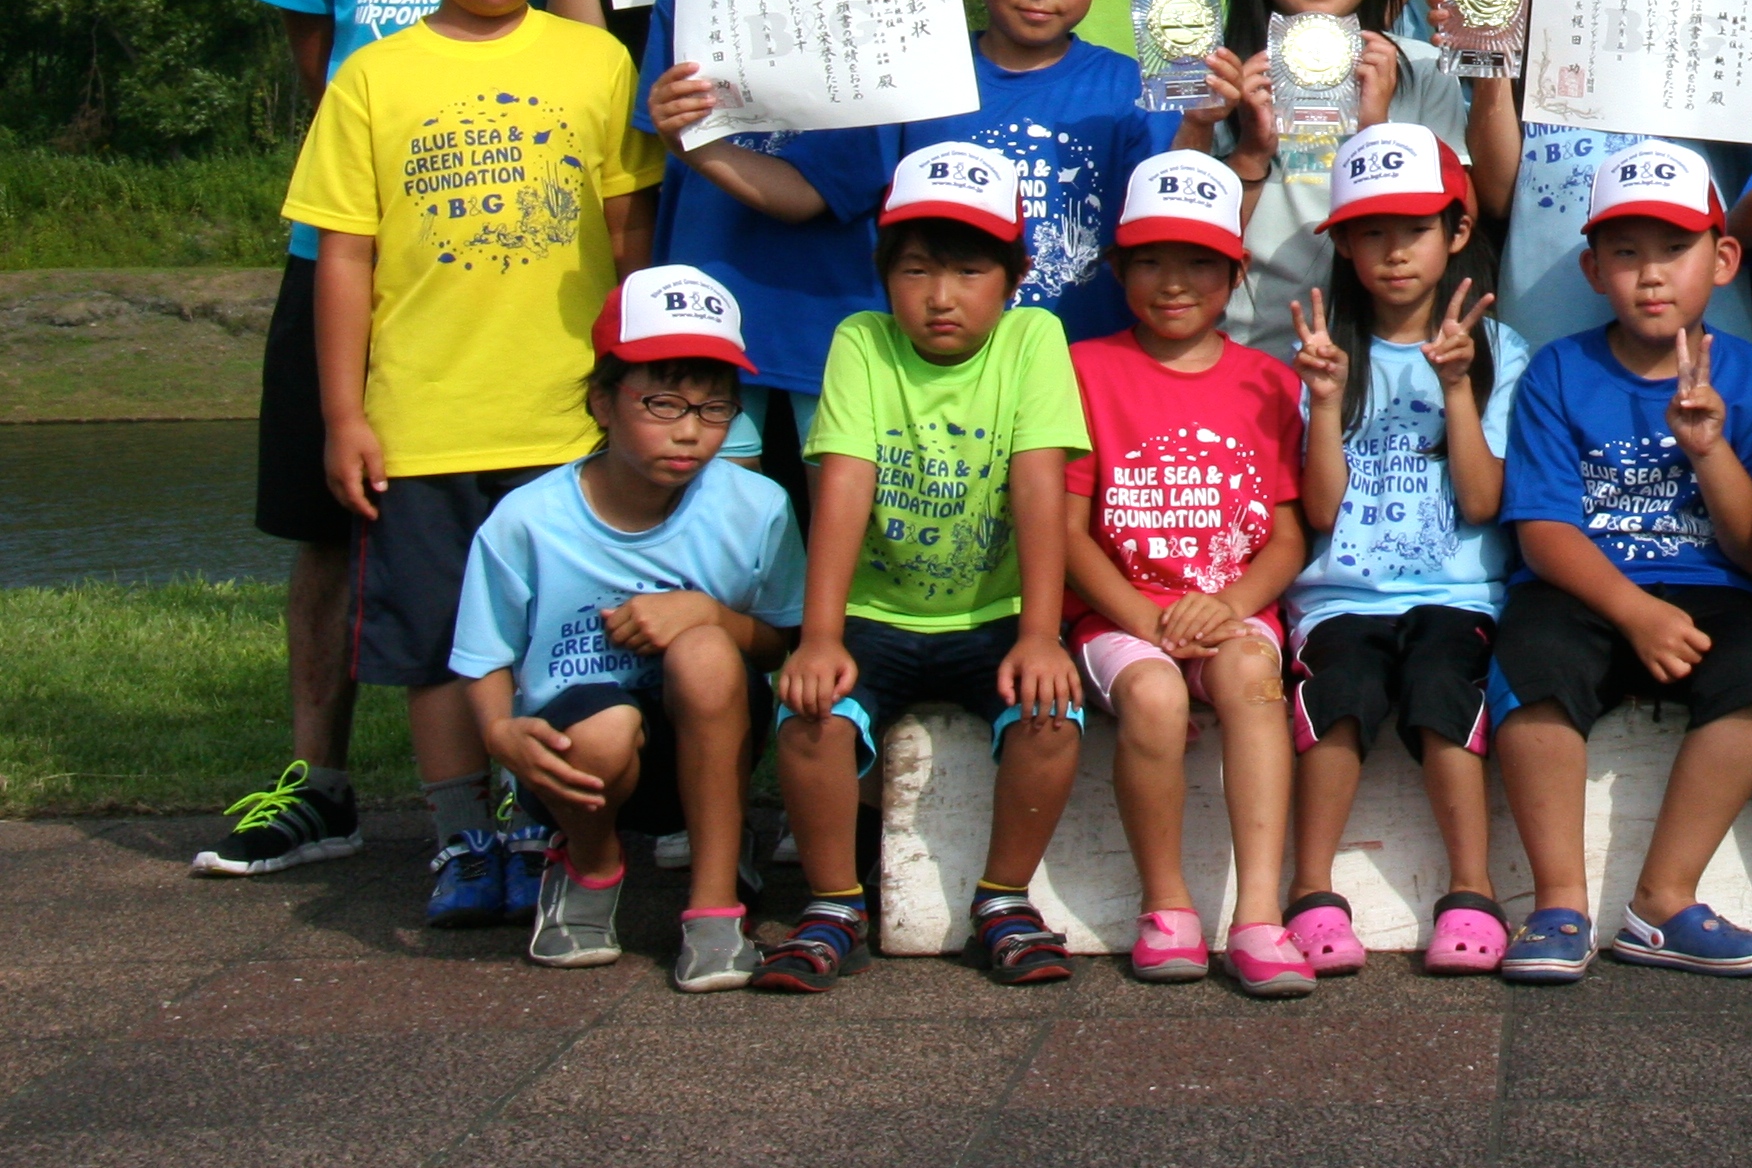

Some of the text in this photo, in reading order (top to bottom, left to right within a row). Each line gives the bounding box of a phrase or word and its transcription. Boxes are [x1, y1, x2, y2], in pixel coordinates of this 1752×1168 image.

[411, 125, 524, 155] BLUE SEA &
[1545, 138, 1593, 163] B&G
[404, 146, 522, 176] GREEN LAND
[1033, 158, 1051, 176] &
[1350, 151, 1405, 179] B&G
[1619, 161, 1677, 183] B&G
[404, 166, 525, 196] FOUNDATION
[927, 162, 990, 186] B&G
[1019, 180, 1047, 197] ND
[1157, 176, 1218, 200] B&G
[448, 194, 505, 219] B&G
[664, 290, 724, 316] B&G
[1415, 435, 1431, 450] &
[919, 456, 949, 477] SEA
[954, 459, 971, 477] &
[1113, 465, 1223, 486] BLUE SEA &
[1346, 455, 1383, 477] REEN
[1580, 460, 1684, 485] BLUE SEA &
[876, 466, 968, 499] REEN LAND
[1351, 473, 1428, 497] UNDATION
[1586, 479, 1622, 499] REEN
[874, 487, 966, 518] UNDATION
[1105, 487, 1221, 507] GREEN LAND
[1103, 508, 1222, 529] FOUNDATION
[1588, 512, 1643, 532] B&G
[884, 517, 941, 546] B&G
[1147, 535, 1199, 559] B&G
[561, 615, 604, 638] BLU
